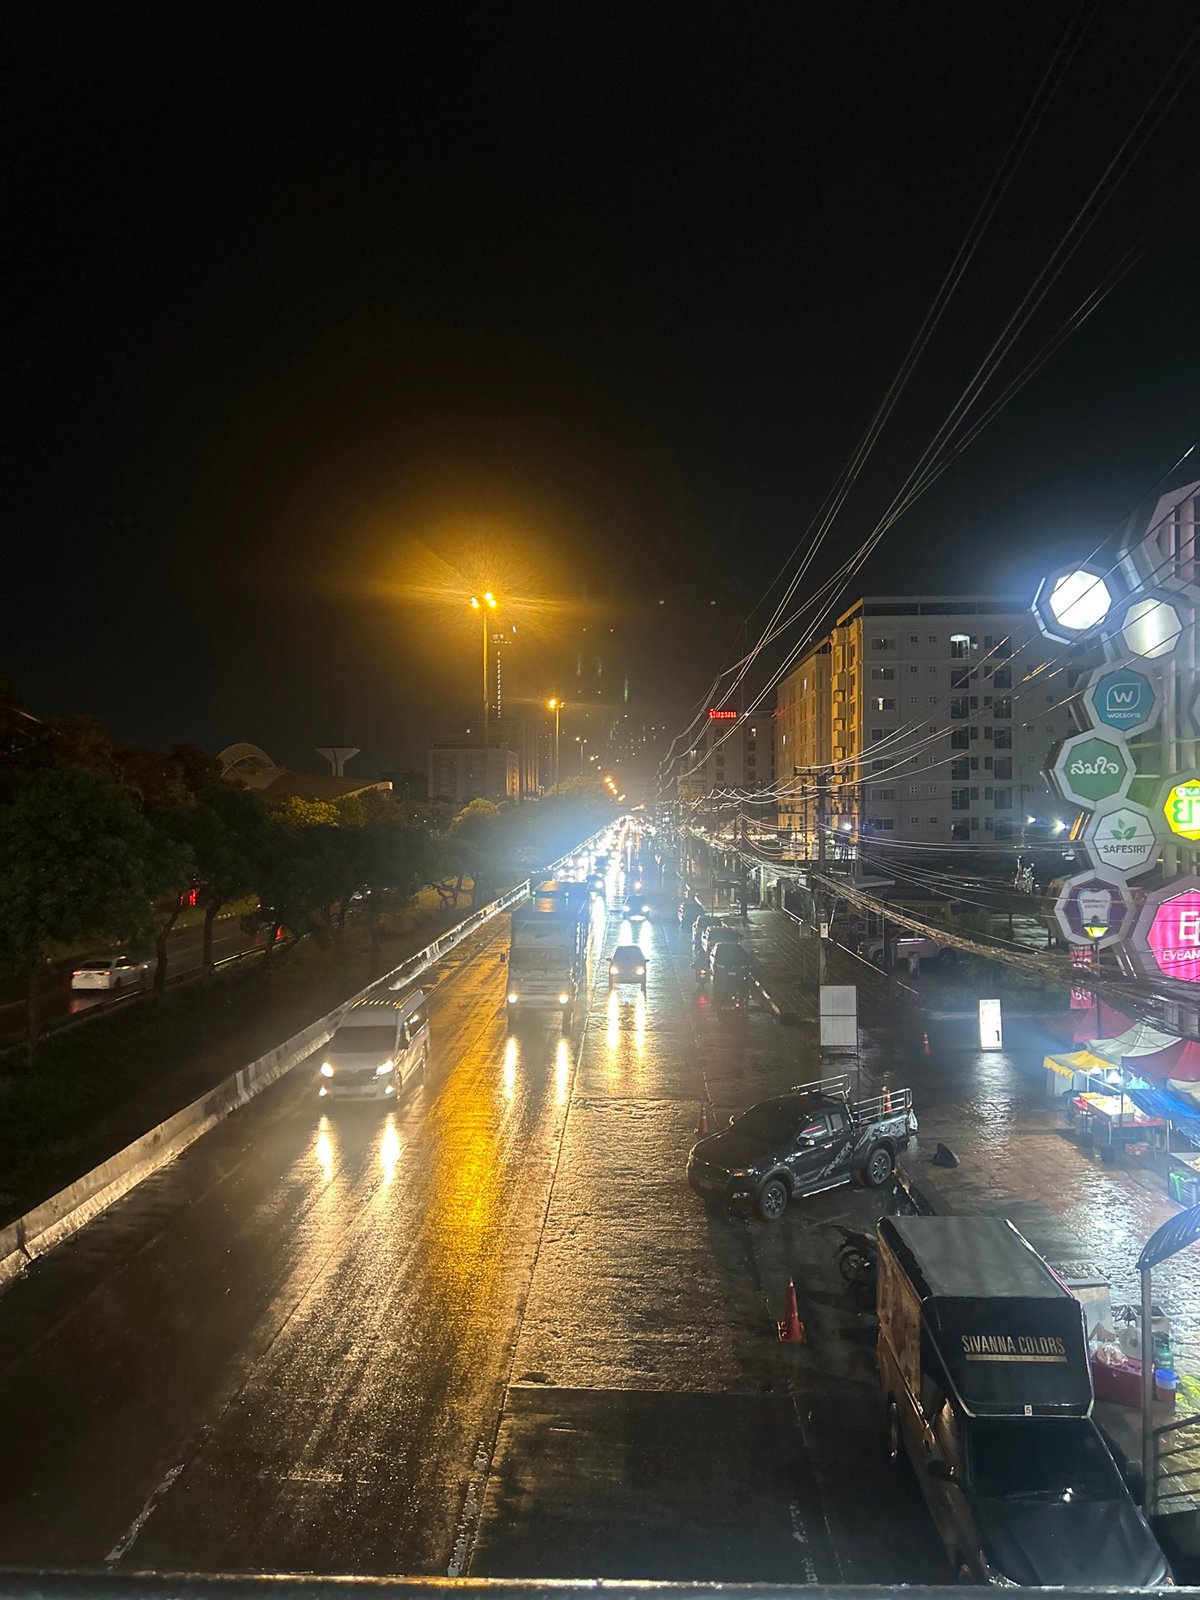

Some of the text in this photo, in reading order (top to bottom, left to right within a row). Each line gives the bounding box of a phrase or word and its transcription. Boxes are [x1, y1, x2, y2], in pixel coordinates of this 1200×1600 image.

[1070, 756, 1119, 775] สมใจ
[1173, 799, 1200, 824] ย
[1103, 844, 1146, 854] SAFESIRI
[962, 1335, 1066, 1354] SIVANNA COLORS
